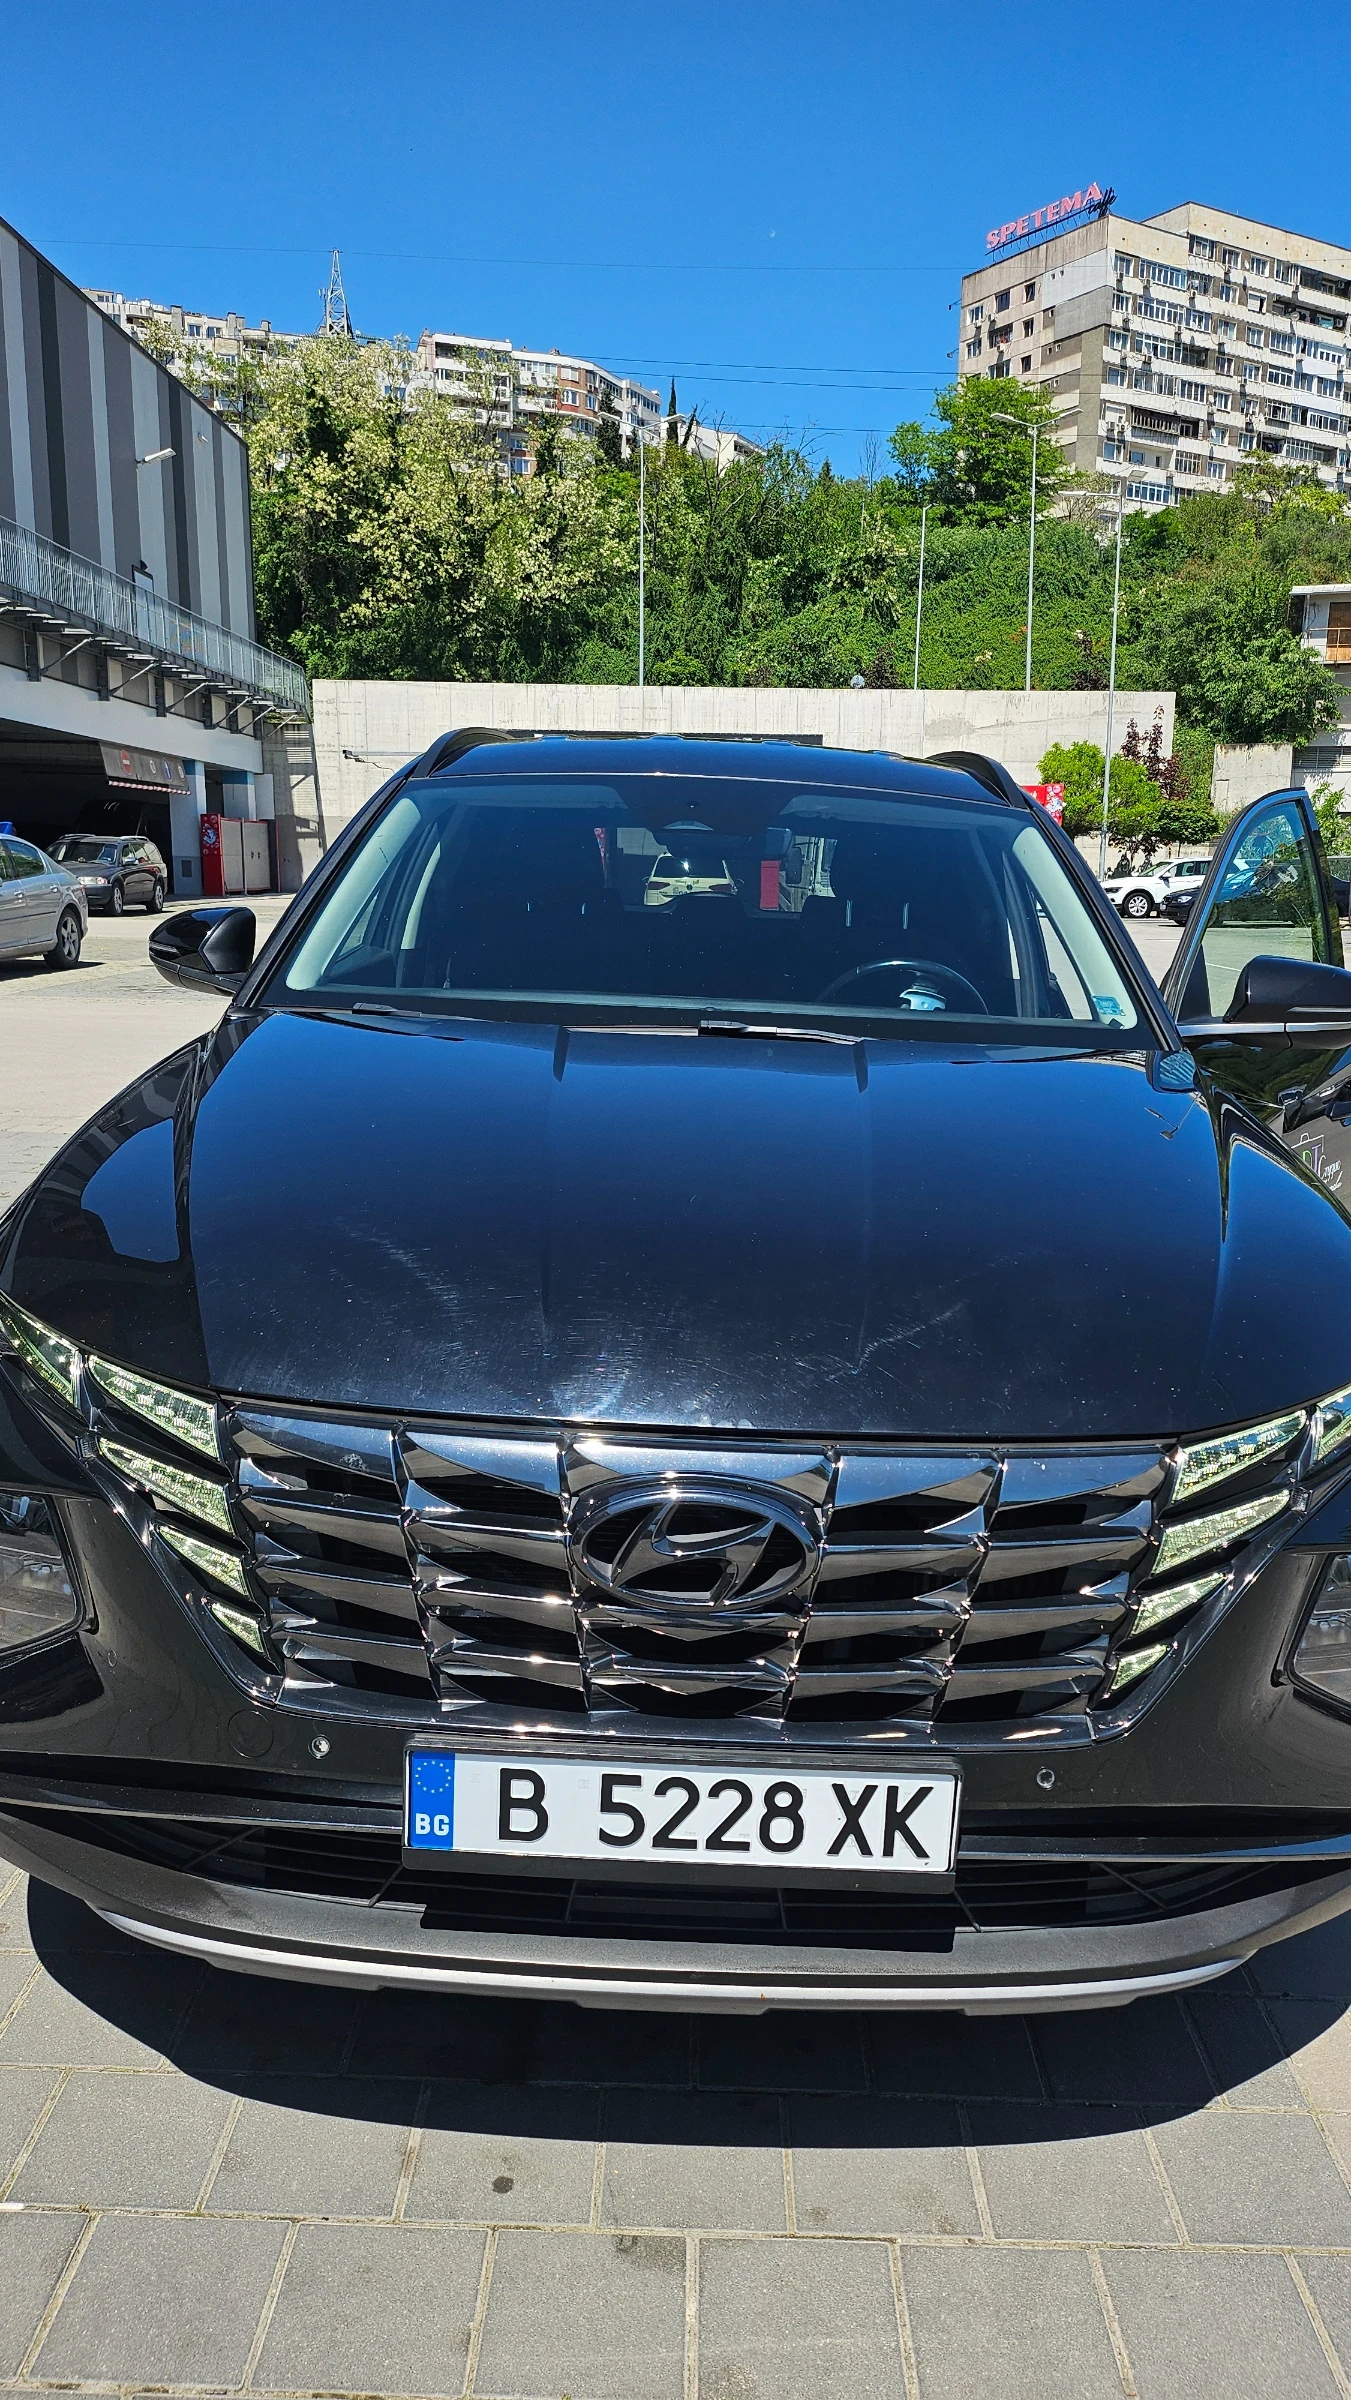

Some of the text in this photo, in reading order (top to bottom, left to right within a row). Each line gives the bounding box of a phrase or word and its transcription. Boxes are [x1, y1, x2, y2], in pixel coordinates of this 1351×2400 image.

[986, 182, 1103, 249] SPETEMA
[415, 1812, 450, 1836] BG
[498, 1767, 934, 1859] B 5228 XK
